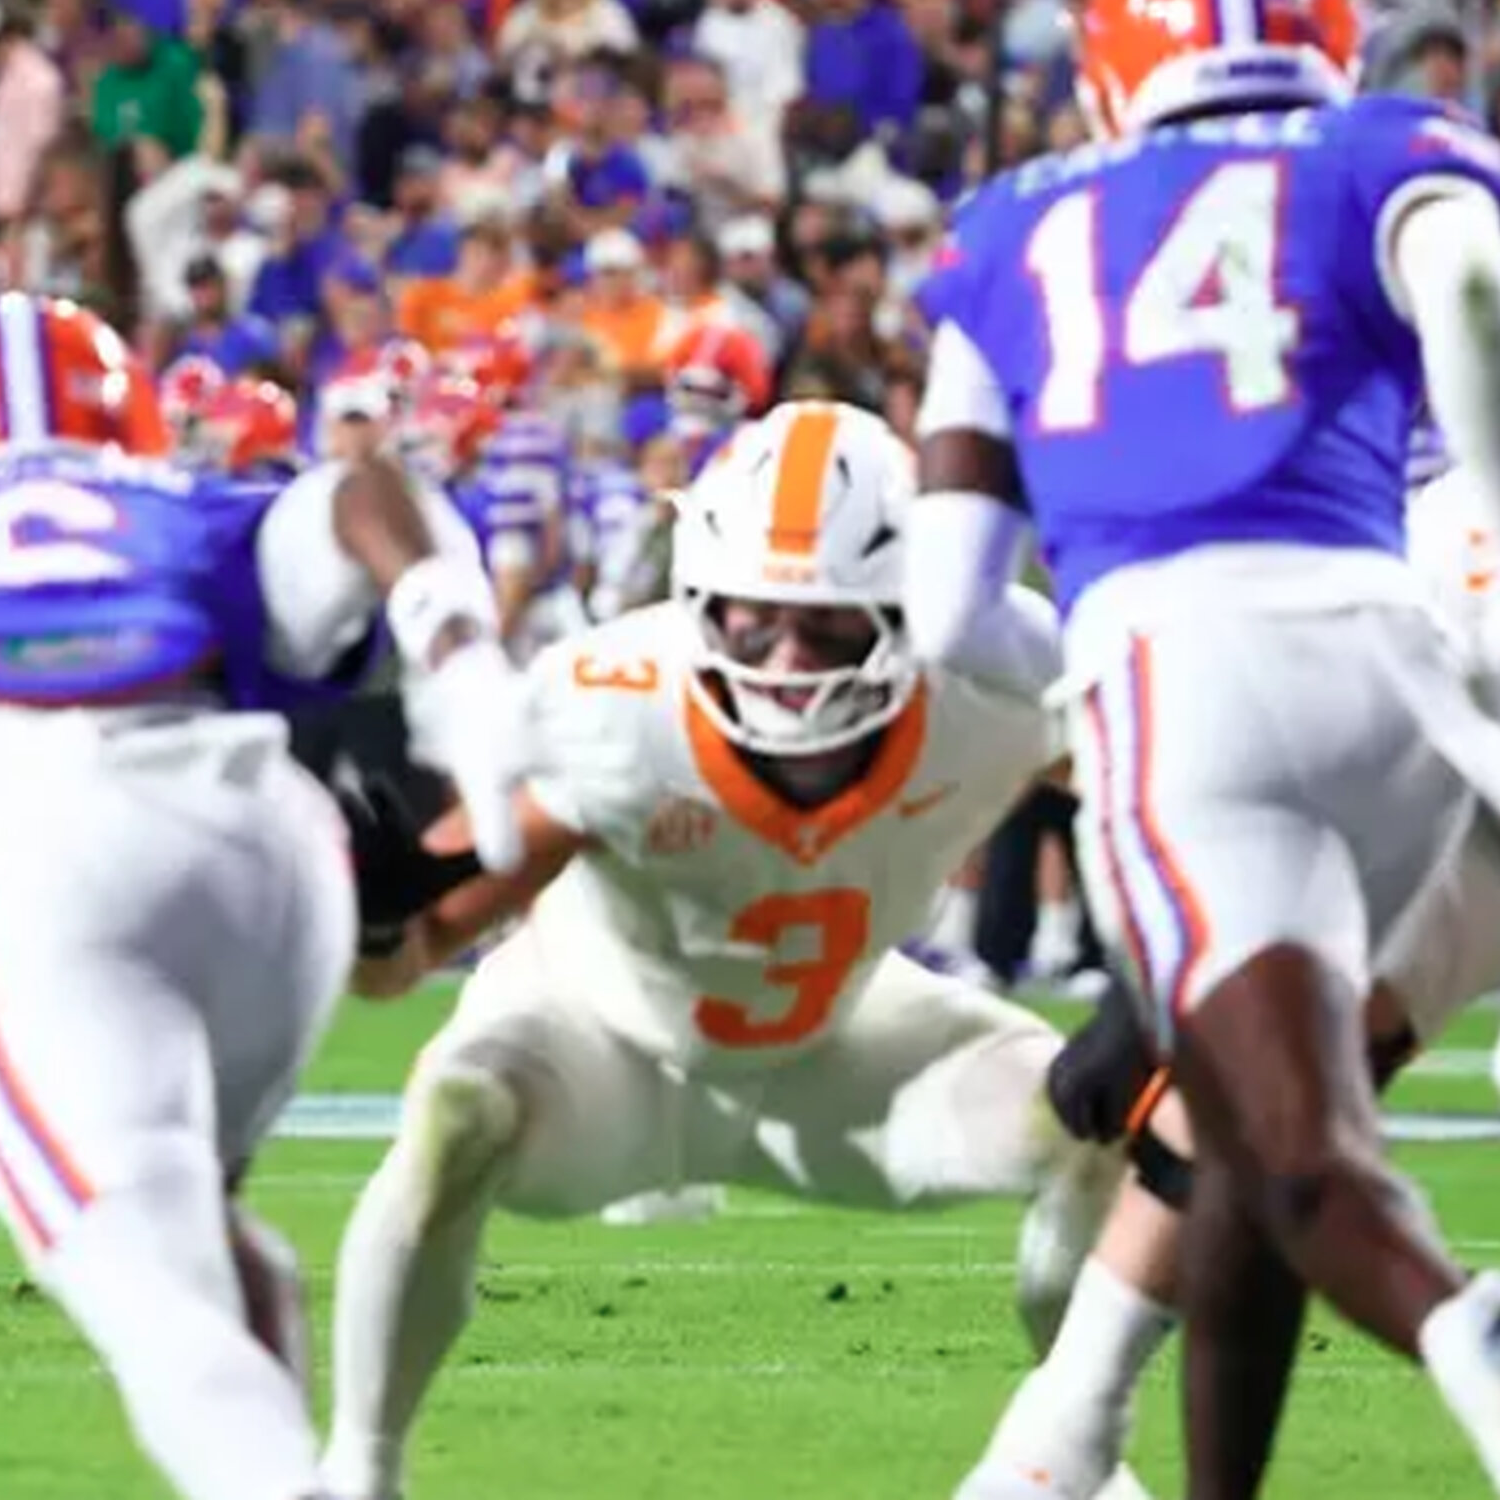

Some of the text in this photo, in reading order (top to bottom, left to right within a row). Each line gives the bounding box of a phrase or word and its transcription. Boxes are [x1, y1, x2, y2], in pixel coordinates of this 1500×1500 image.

[1025, 156, 1300, 437] 14
[572, 653, 659, 691] 3
[692, 887, 871, 1050] 3
